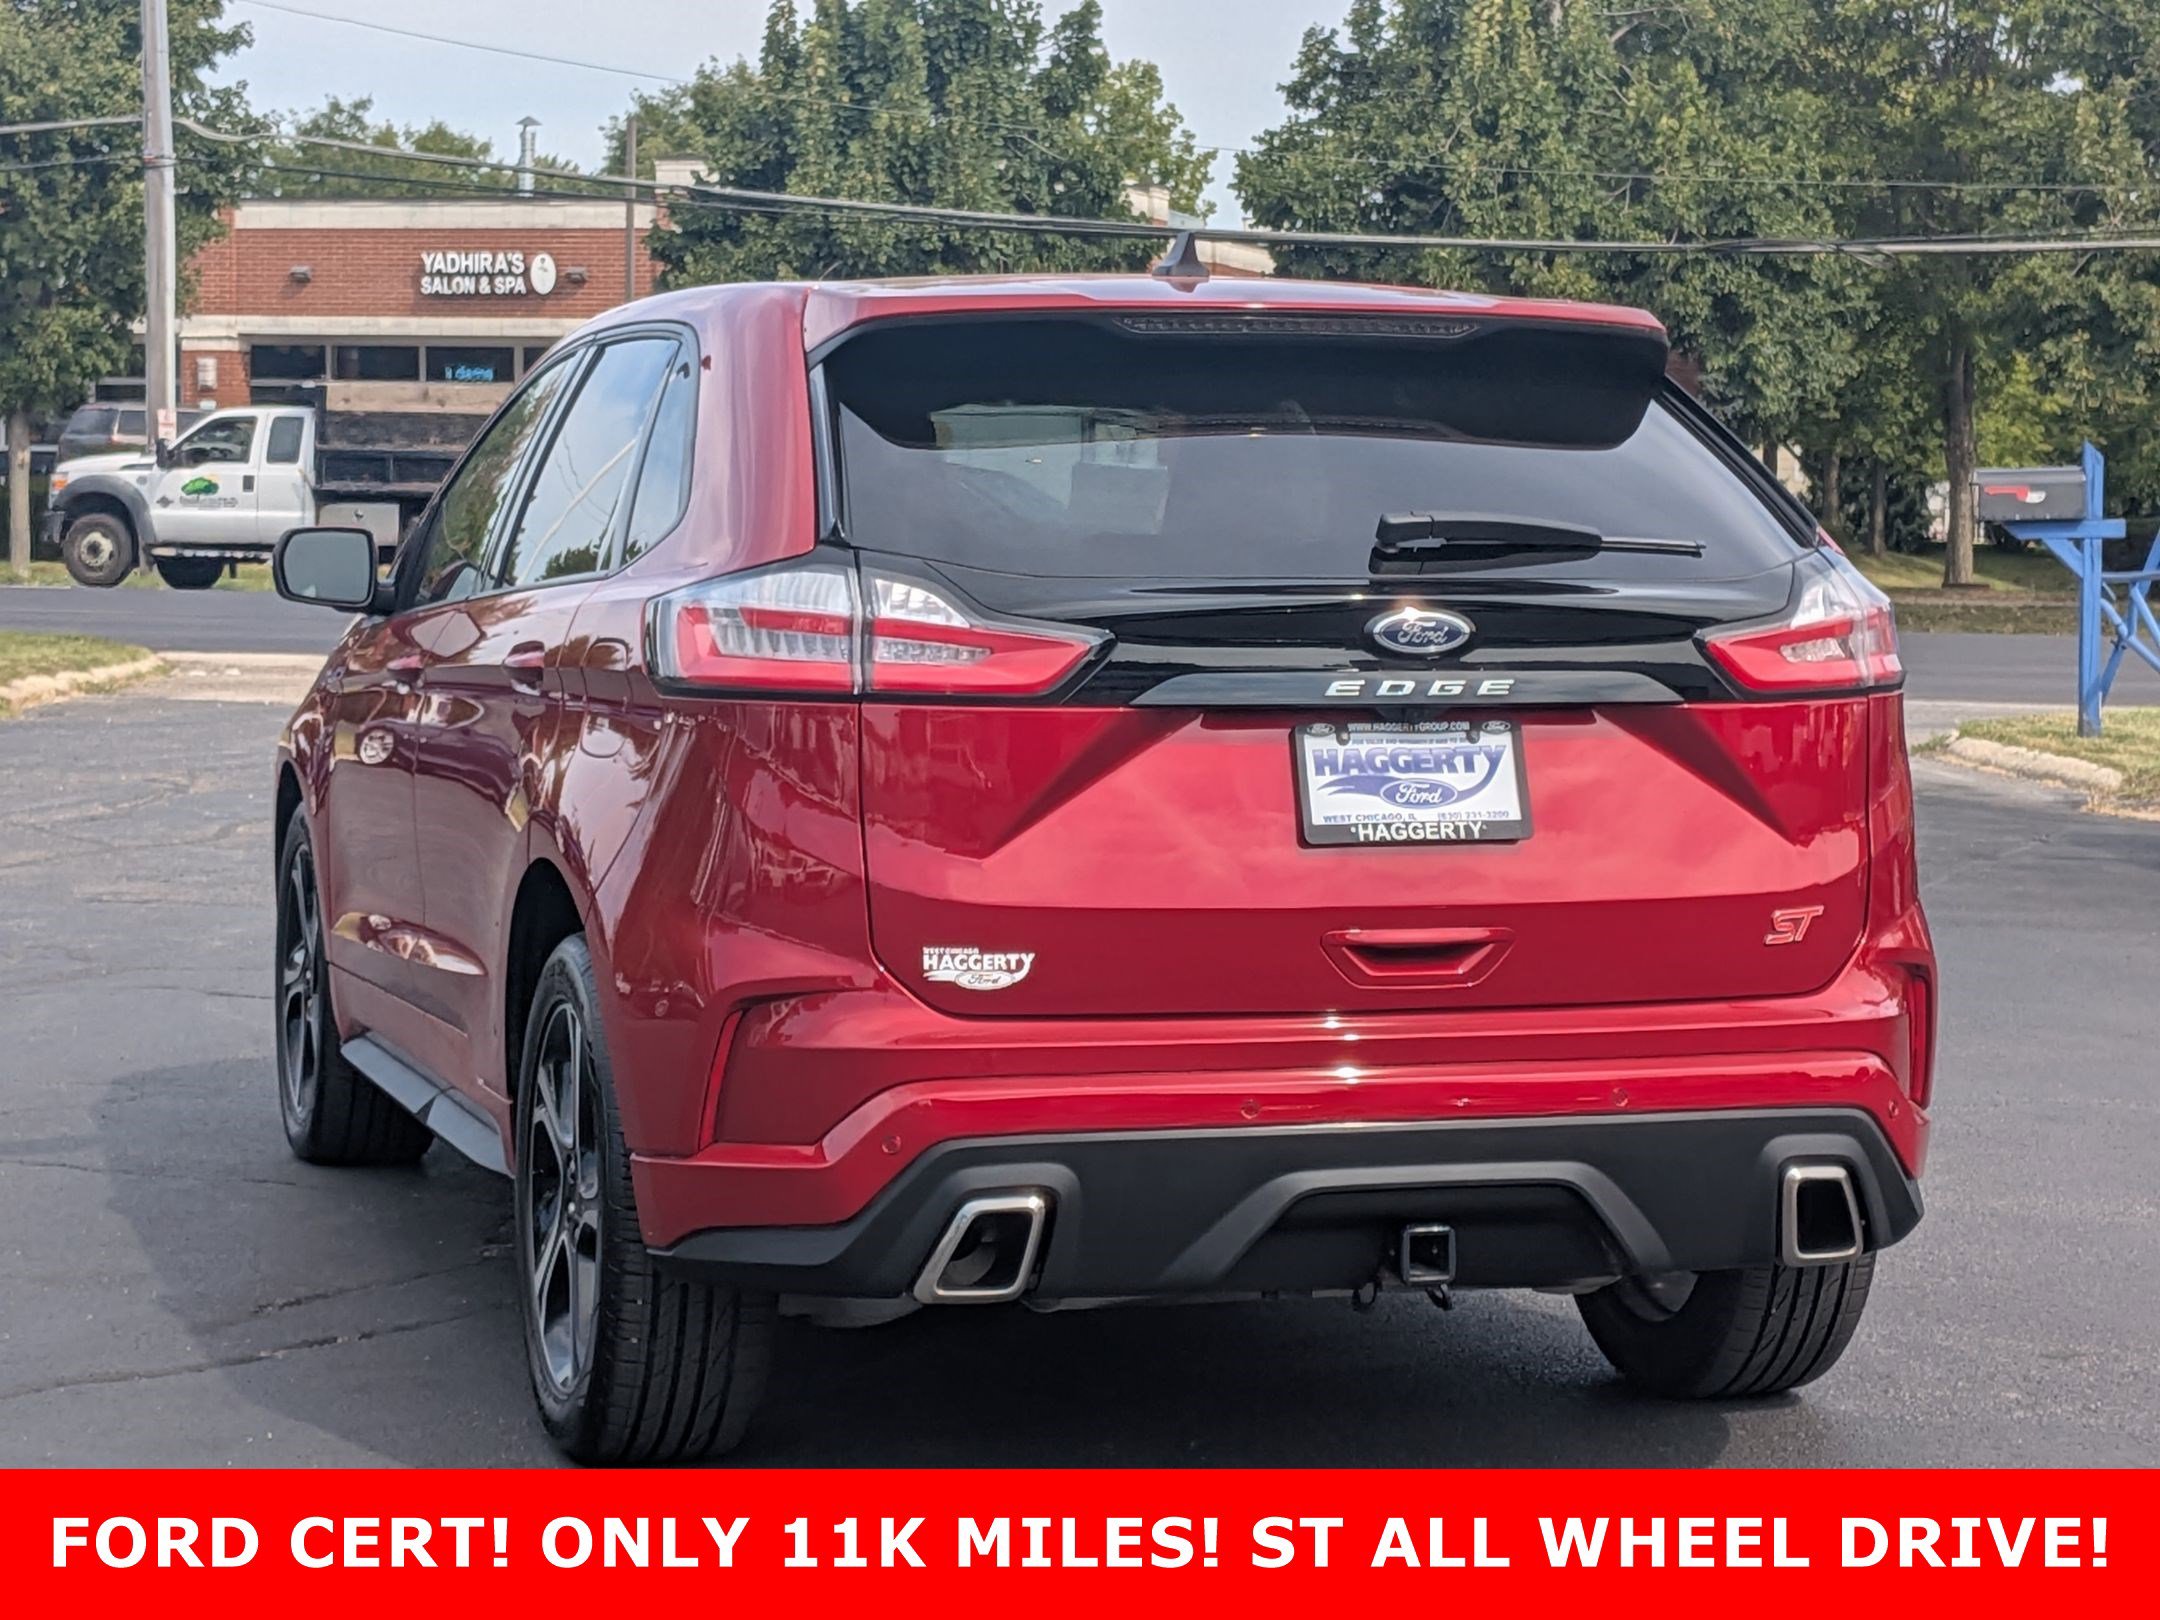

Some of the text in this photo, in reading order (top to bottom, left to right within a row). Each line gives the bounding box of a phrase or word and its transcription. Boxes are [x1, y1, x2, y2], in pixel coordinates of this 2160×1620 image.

[420, 252, 525, 274] YADHIRA'S
[420, 276, 527, 295] SALON & SPA
[1397, 619, 1449, 644] Ford
[1324, 679, 1515, 697] EDGE
[1312, 745, 1507, 777] HAGGERTY
[1395, 783, 1442, 804] Ford
[1323, 814, 1352, 823] WEST
[1357, 820, 1482, 842] HAGGERTY
[1764, 905, 1824, 945] ST
[923, 953, 1035, 970] HAGGERTY
[967, 974, 1001, 984] Ford
